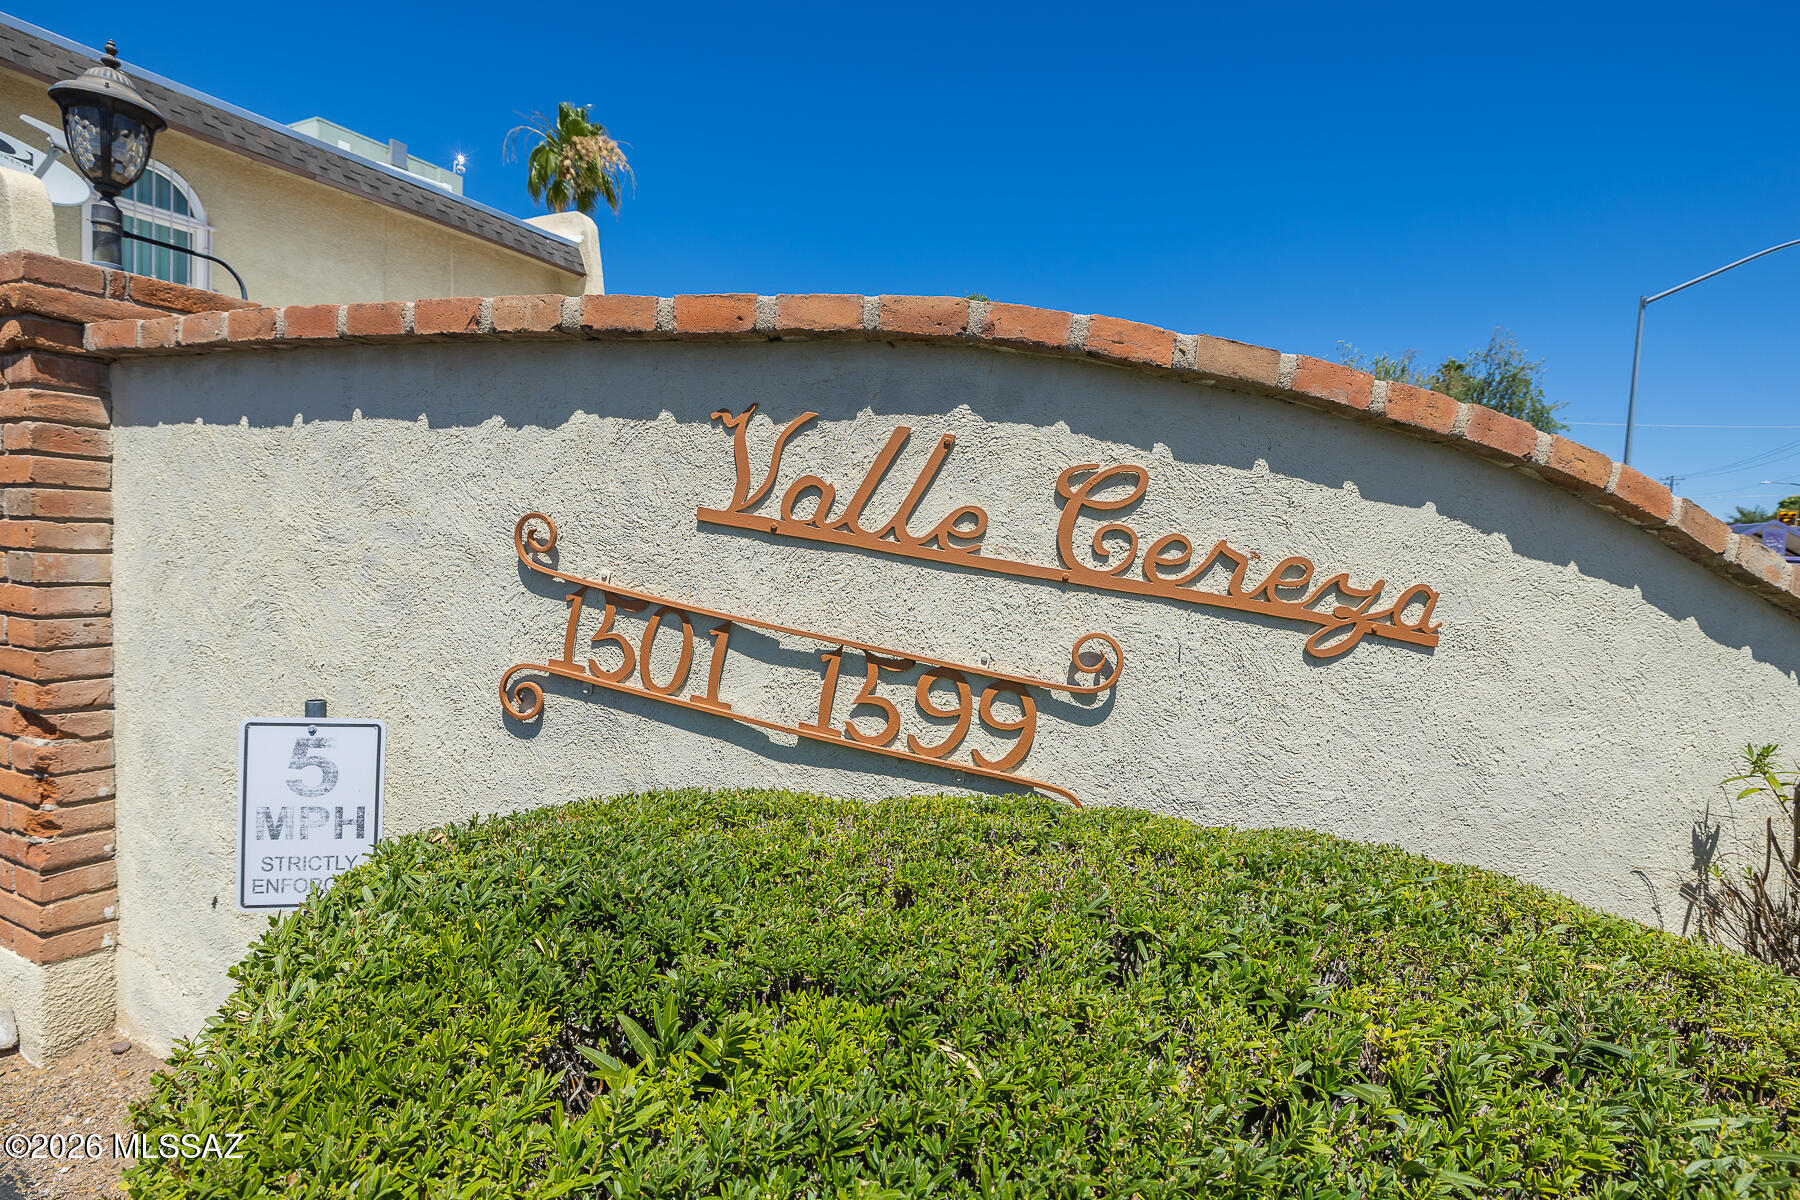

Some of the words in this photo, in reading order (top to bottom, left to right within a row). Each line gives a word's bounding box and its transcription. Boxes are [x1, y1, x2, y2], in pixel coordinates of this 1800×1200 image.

[708, 402, 989, 556] Valle
[1055, 463, 1443, 659] Cereza
[547, 586, 733, 712] 1501
[798, 644, 1037, 772] 1599
[286, 737, 339, 797] 5
[255, 806, 366, 841] MPH
[251, 877, 335, 895] ENFORC
[260, 855, 358, 872] STRICTLY
